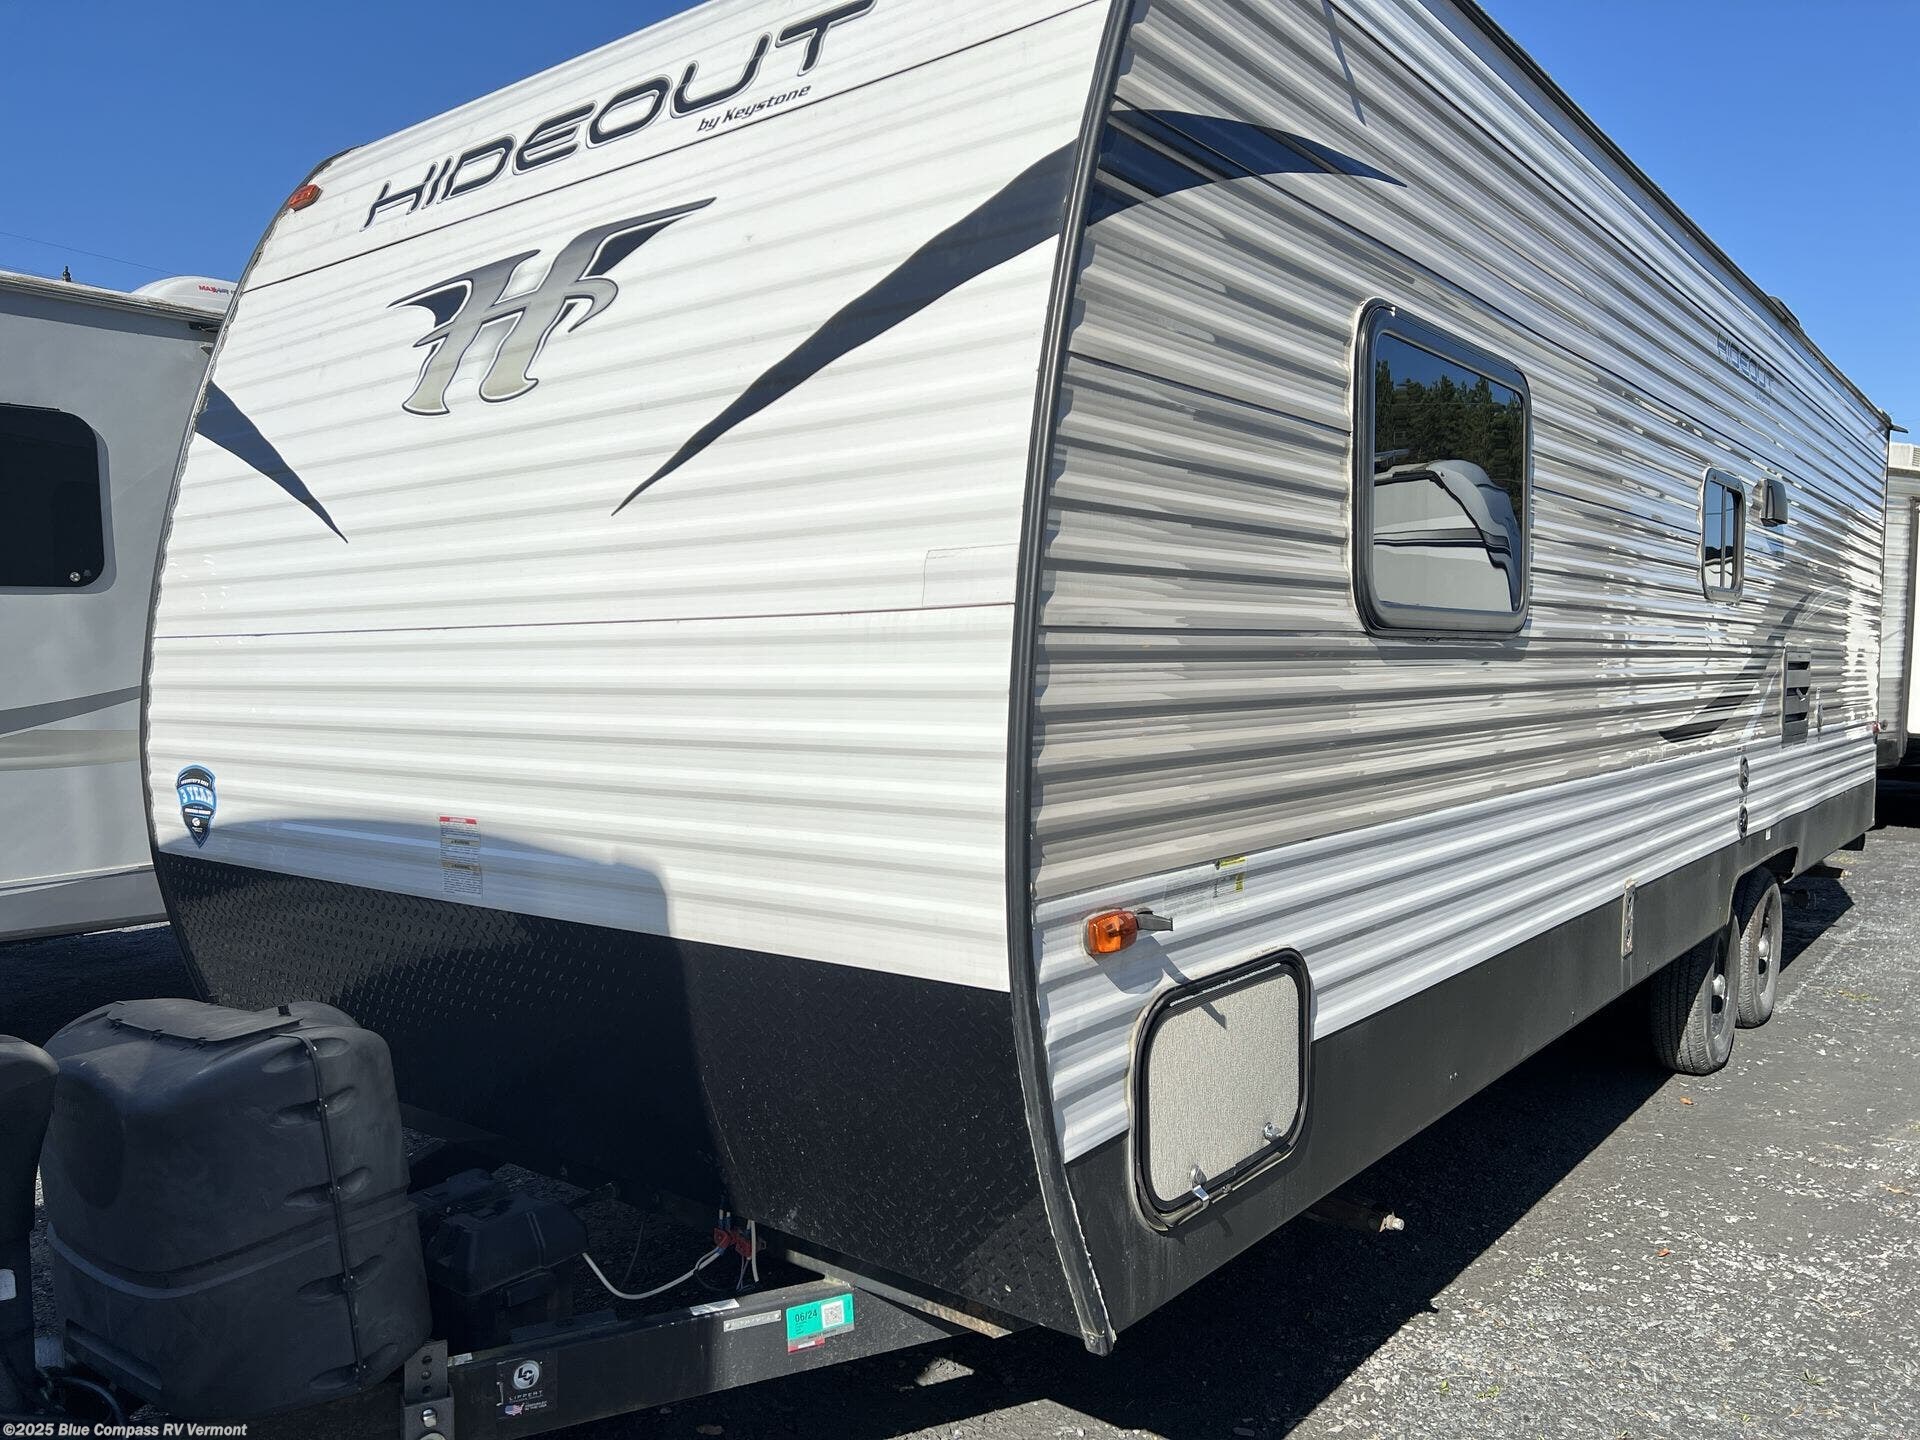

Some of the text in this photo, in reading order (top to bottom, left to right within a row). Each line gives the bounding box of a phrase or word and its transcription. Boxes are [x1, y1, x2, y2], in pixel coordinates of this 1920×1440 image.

[360, 0, 877, 232] HIDEOUT
[697, 84, 812, 132] by Keystone
[1716, 331, 1776, 394] HIDEOUT
[179, 785, 214, 807] 3 YEAR
[794, 1309, 818, 1323] 06/24
[509, 1389, 543, 1401] LIPPERT
